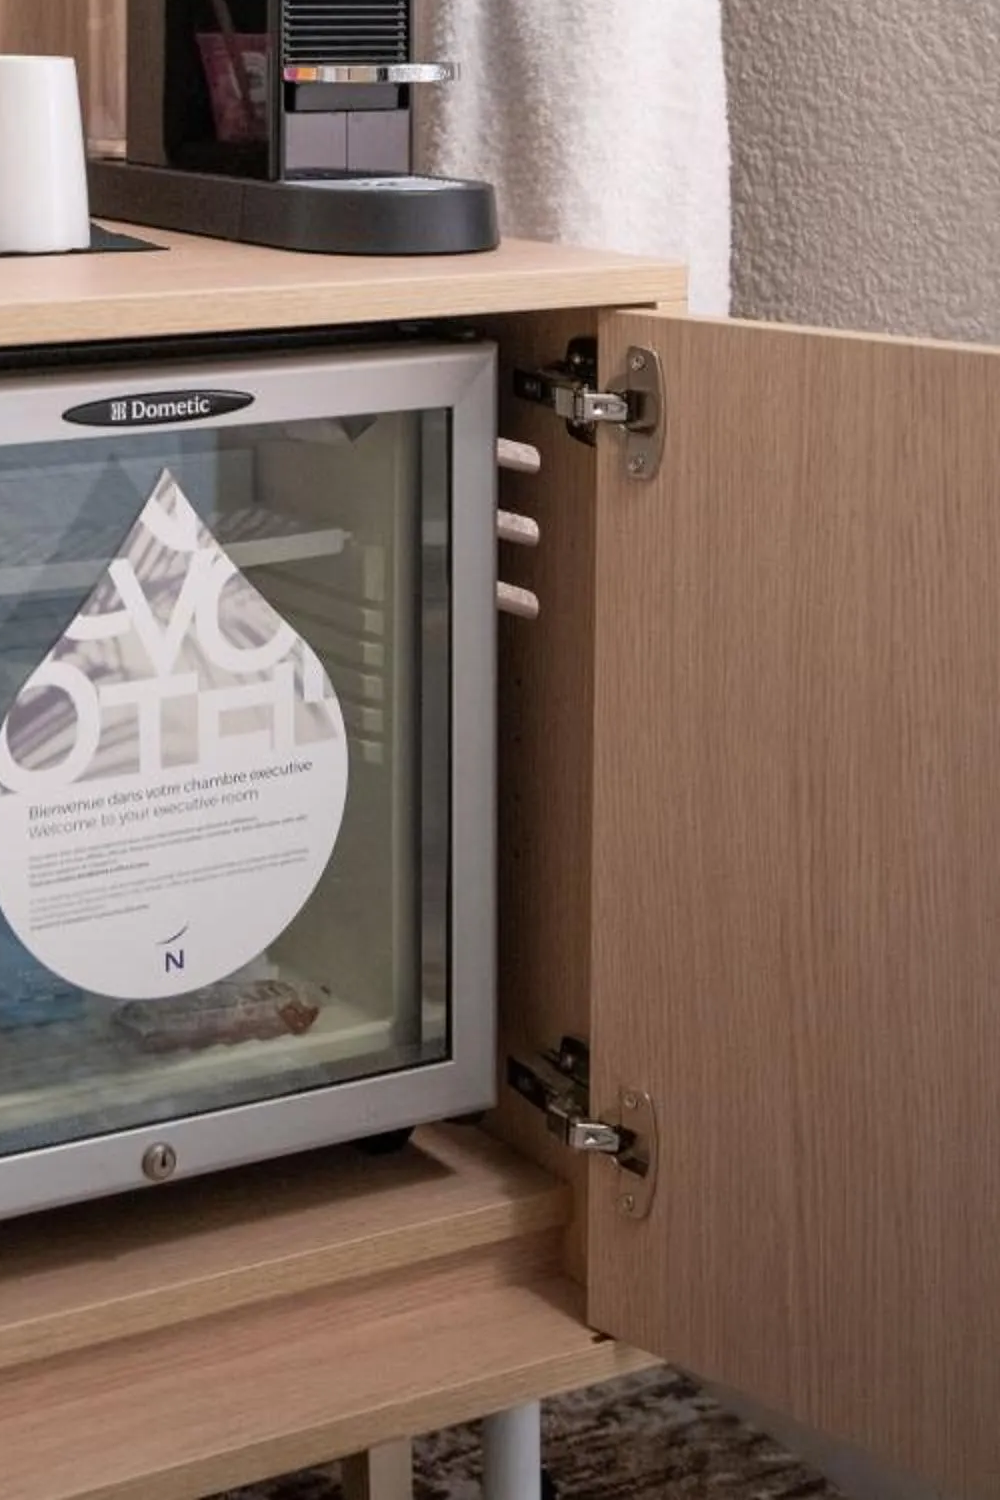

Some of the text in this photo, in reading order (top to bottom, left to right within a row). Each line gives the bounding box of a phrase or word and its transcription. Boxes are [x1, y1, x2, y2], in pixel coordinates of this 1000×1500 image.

[131, 395, 211, 419] Dometic
[28, 797, 105, 820] Bienvenue
[107, 787, 143, 805] dans
[145, 782, 181, 798] votre
[183, 771, 247, 794] chambre
[28, 788, 260, 840] Welcome to your executive room
[165, 949, 185, 973] N
